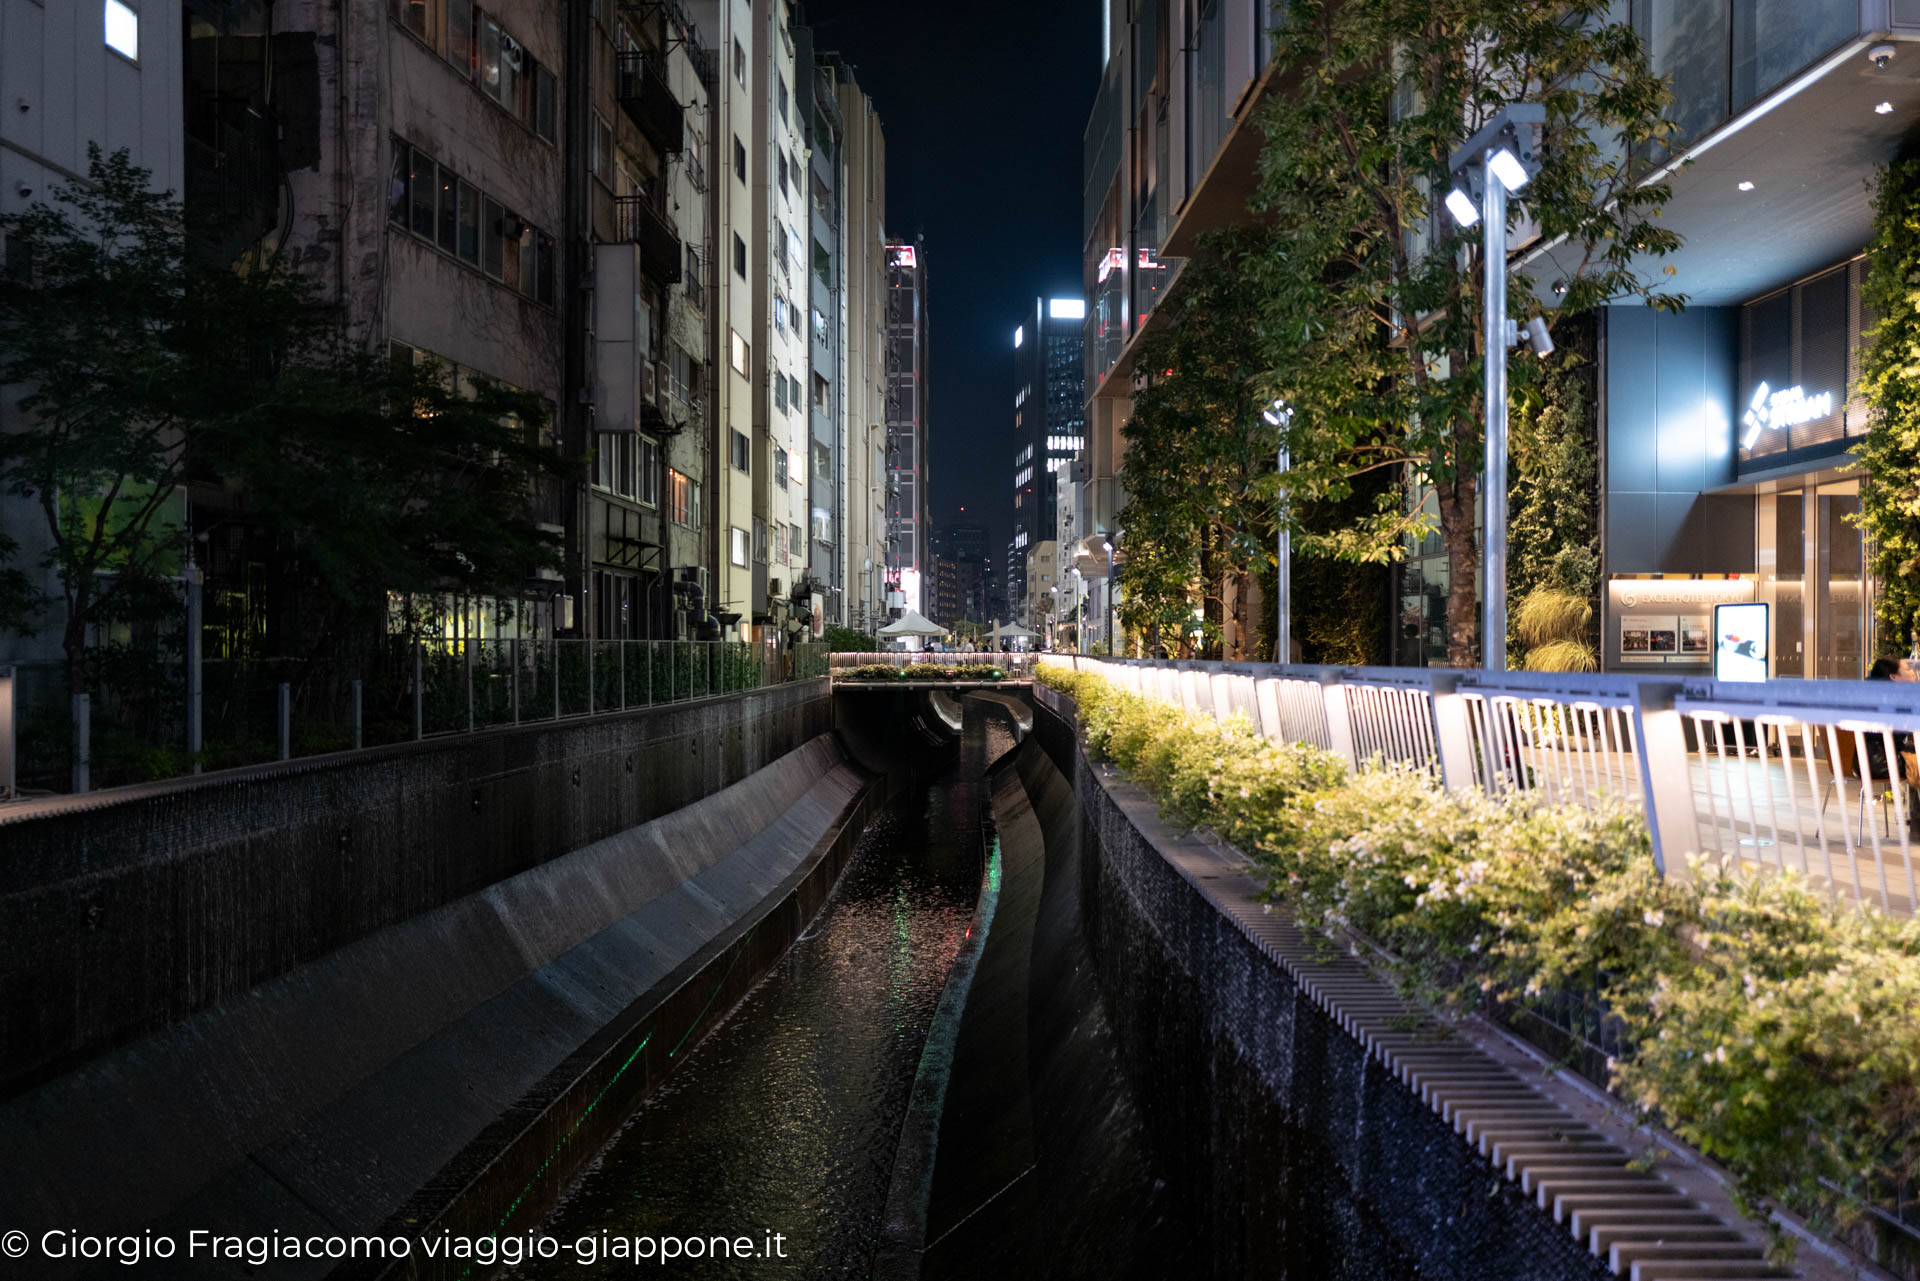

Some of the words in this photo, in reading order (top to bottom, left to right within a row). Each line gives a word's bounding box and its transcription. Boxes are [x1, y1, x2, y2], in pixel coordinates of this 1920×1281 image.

[1641, 591, 1672, 604] EXCEL
[1674, 591, 1705, 604] HOTEL
[1710, 590, 1743, 604] TOKYU
